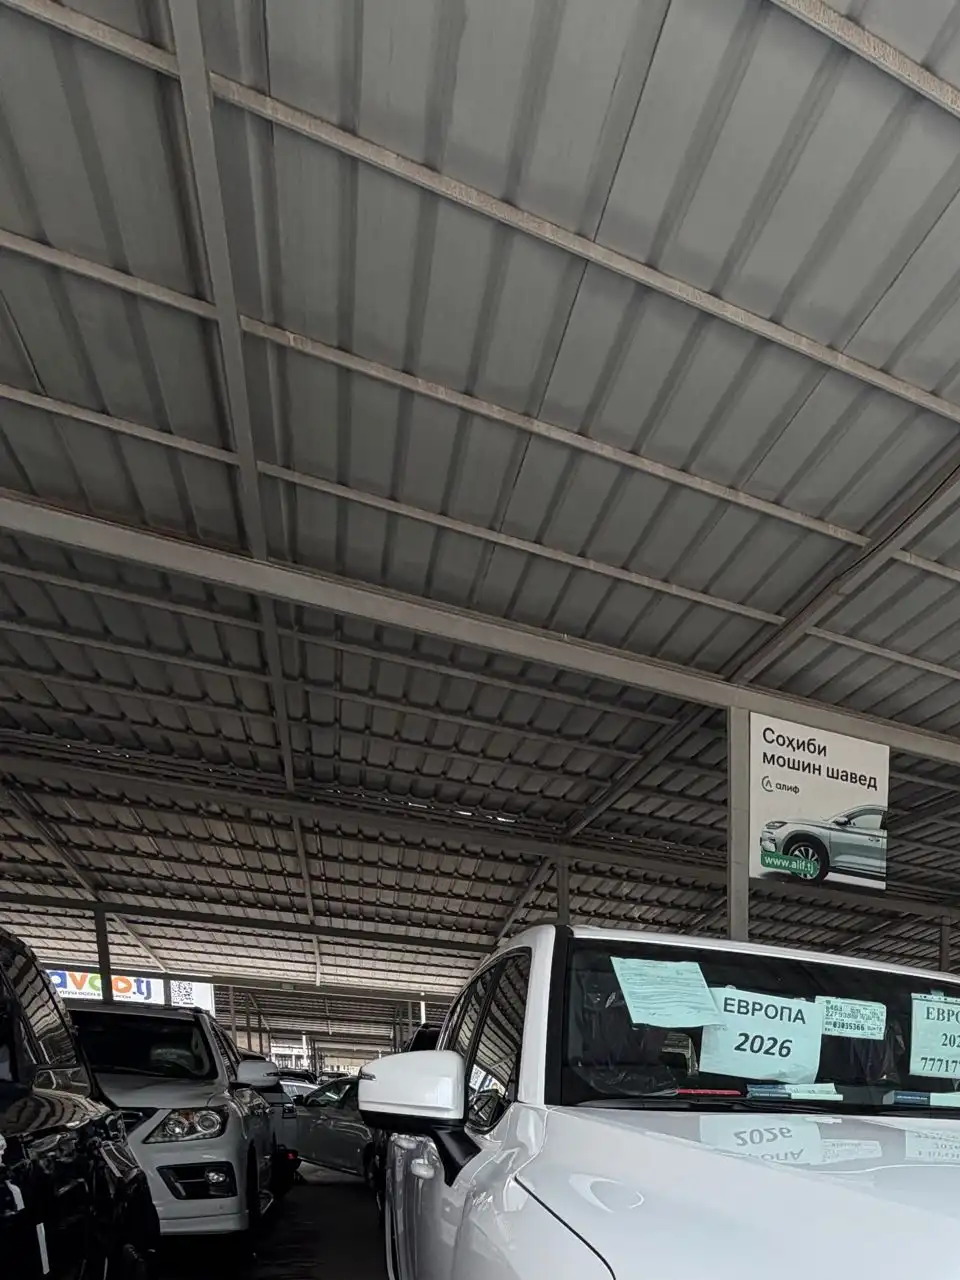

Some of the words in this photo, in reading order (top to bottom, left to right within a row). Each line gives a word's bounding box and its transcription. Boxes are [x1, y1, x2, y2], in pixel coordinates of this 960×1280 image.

[762, 727, 827, 757] Соҳиби
[762, 752, 822, 776] мошин
[826, 766, 878, 791] шавед
[775, 784, 800, 794] алиф
[764, 856, 814, 873] www.alif.tj
[723, 997, 806, 1024] ЕВРОПА
[734, 1032, 793, 1058] 2026
